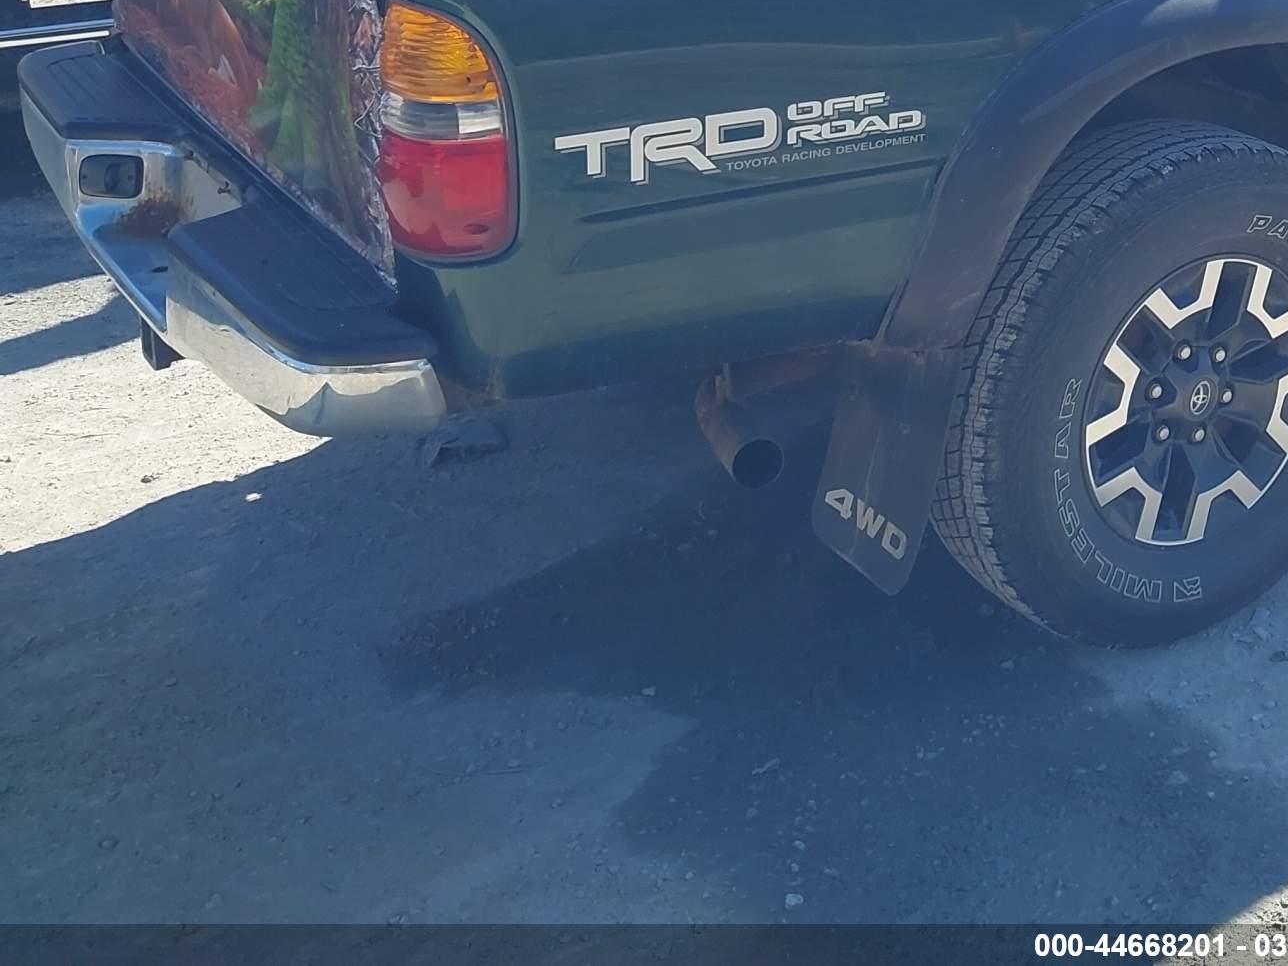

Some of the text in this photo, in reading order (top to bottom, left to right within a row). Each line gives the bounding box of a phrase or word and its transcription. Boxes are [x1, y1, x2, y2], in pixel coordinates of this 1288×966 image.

[787, 91, 889, 121] OFF
[787, 109, 926, 148] ROAD
[555, 107, 781, 185] TRD
[725, 134, 927, 172] TOYOTA RACING DEVELOPMENT
[1053, 377, 1163, 603] MILESTAR
[825, 488, 907, 560] 4WD
